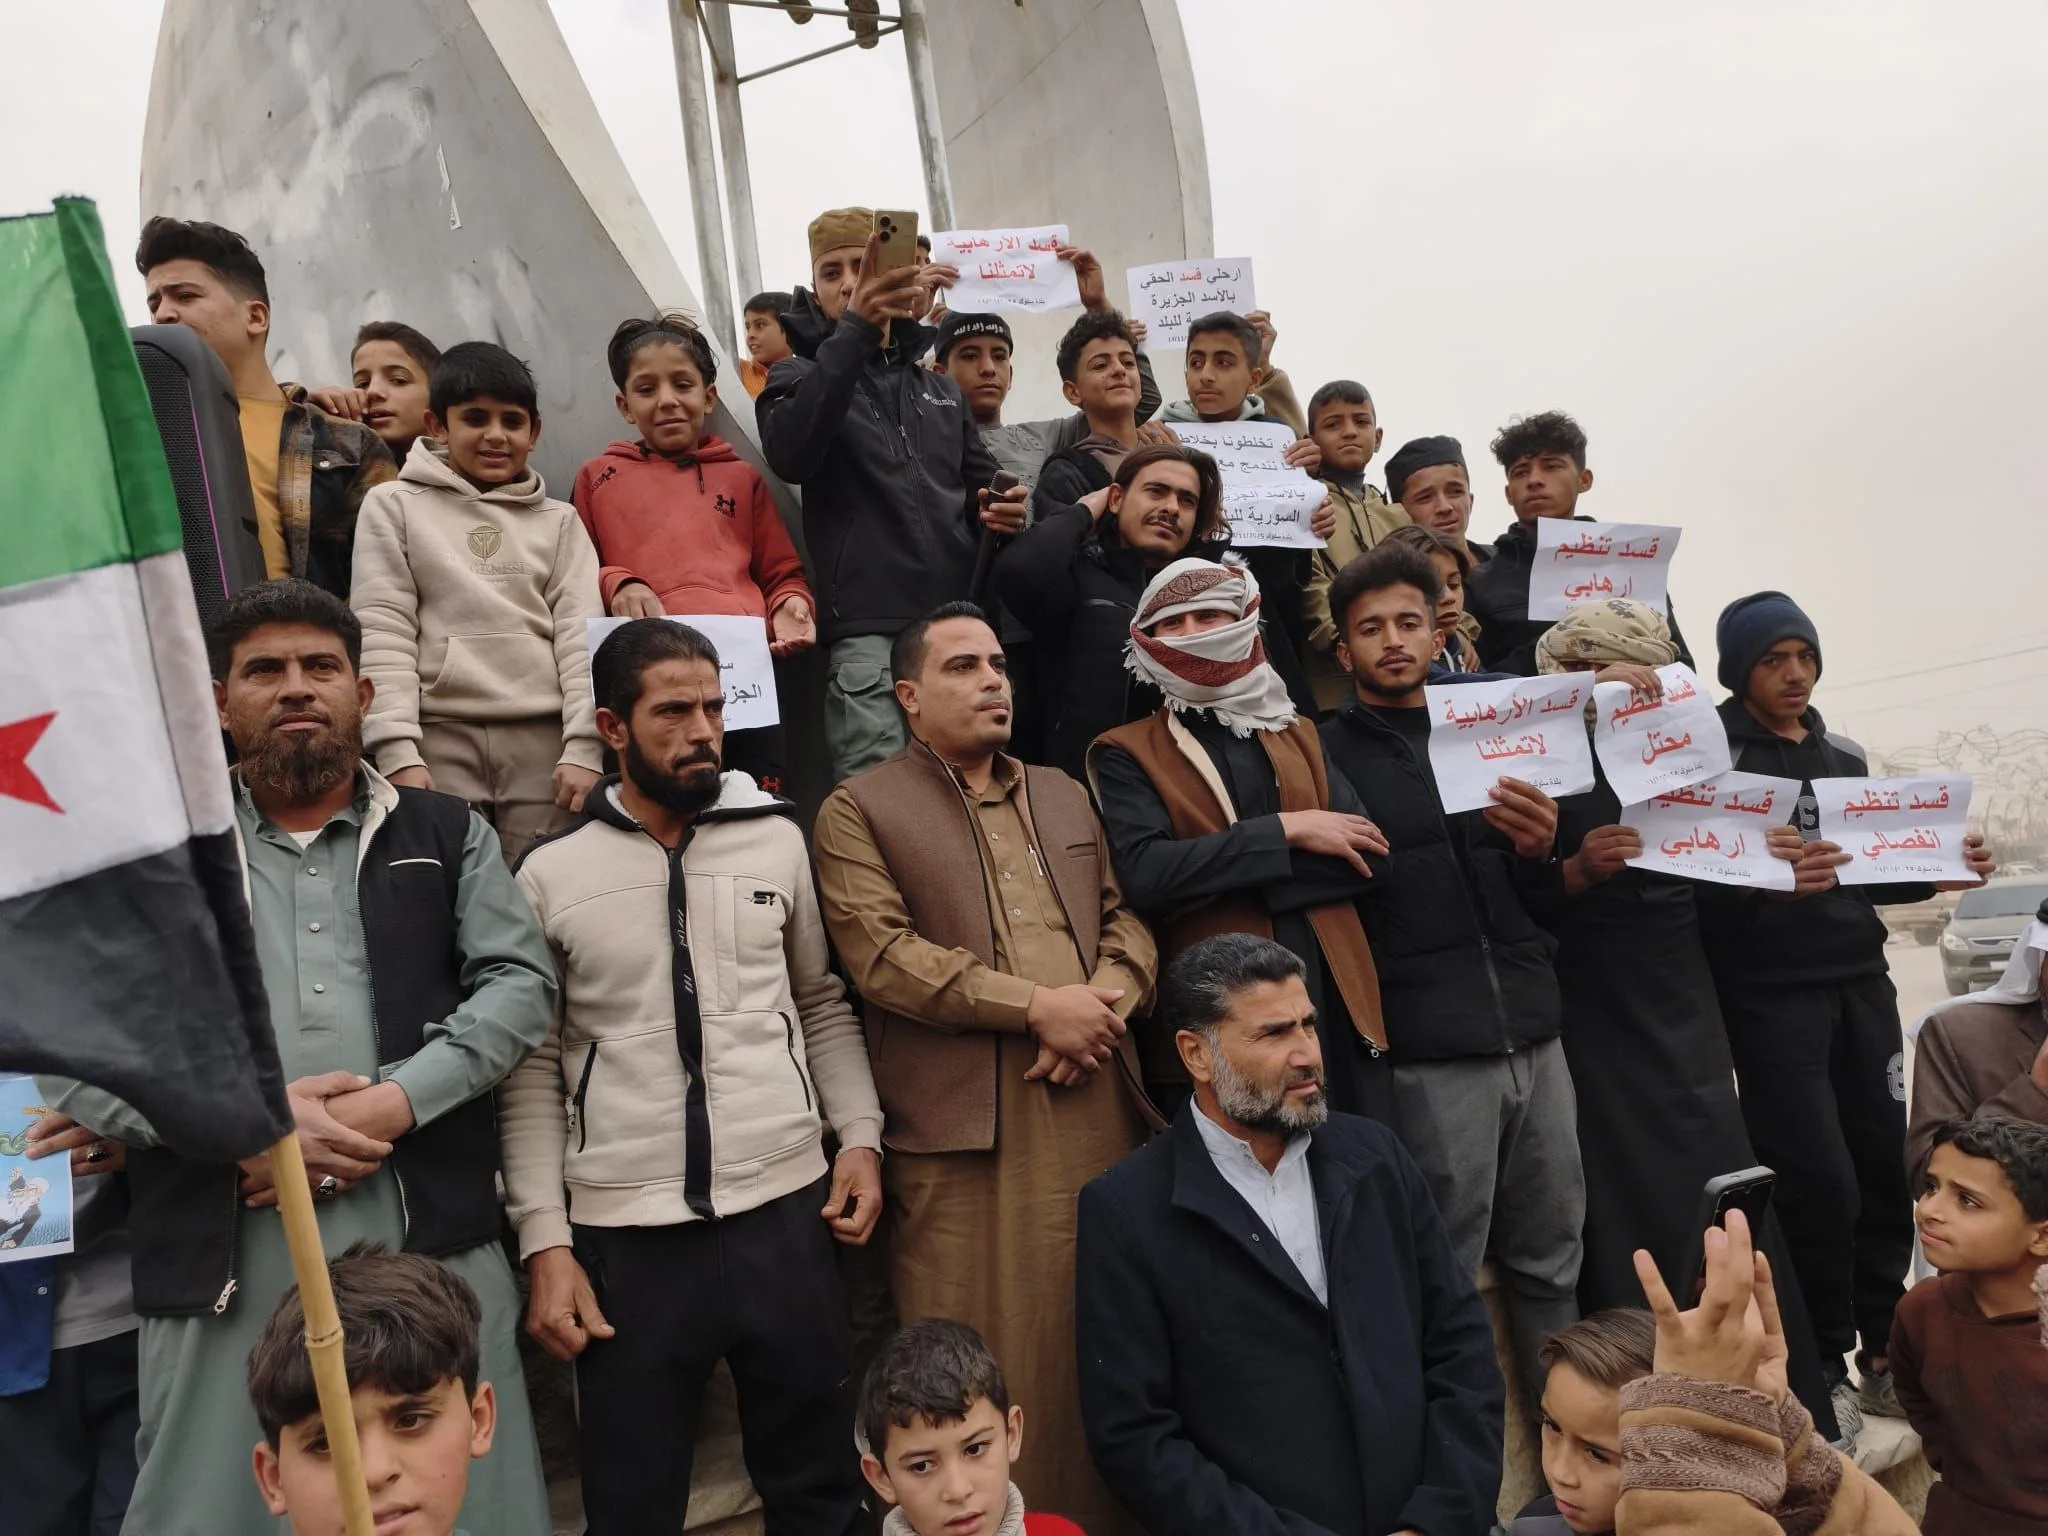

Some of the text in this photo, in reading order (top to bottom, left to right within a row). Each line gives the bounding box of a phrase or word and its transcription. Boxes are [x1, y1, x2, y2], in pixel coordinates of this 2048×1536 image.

[1028, 234, 1058, 252] قسد
[1140, 267, 1242, 289] ارحلي قسد الحقي
[1151, 291, 1195, 309] الجزيرة
[1158, 314, 1182, 330] للبلد
[1179, 433, 1218, 449] بخلاط
[1222, 435, 1273, 451] تخلطونا
[1224, 506, 1300, 525] السورية للبل
[1554, 532, 1660, 562] قسد تنظيم
[1540, 687, 1580, 714] قسد
[1610, 688, 1664, 736] تنظيم
[1641, 730, 1693, 766] محتل
[1724, 789, 1776, 815] قسد
[1843, 788, 1900, 823] تنظيم
[1908, 784, 1950, 811] قسد
[1862, 828, 1942, 861] انفصالي
